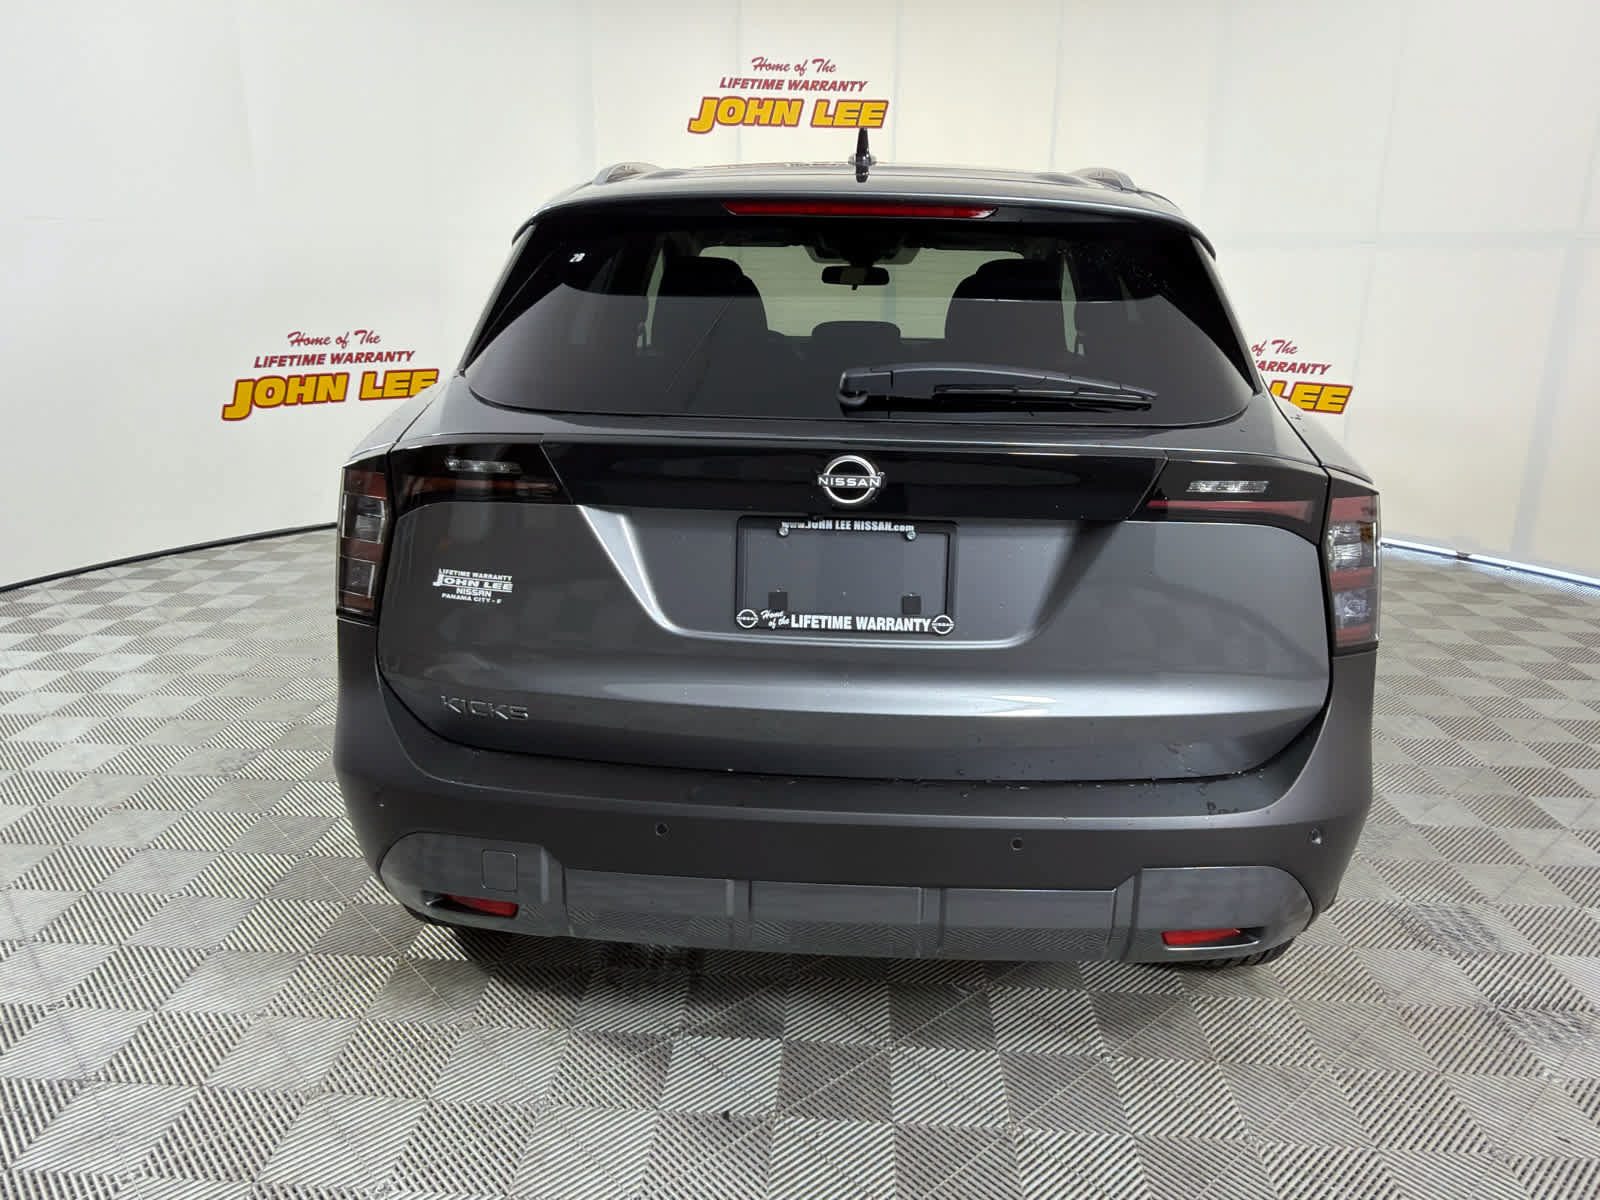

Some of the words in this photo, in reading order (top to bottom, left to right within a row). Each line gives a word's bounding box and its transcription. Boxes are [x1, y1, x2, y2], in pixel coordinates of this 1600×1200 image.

[751, 56, 790, 72] Home
[794, 59, 808, 76] of
[812, 58, 836, 73] The
[719, 77, 784, 90] LIFETIME
[787, 79, 868, 92] WARRANTY
[687, 95, 804, 134] JOHN
[810, 99, 889, 128] LEE
[287, 331, 331, 347] Home
[335, 332, 350, 349] of
[353, 329, 381, 345] The
[1250, 340, 1267, 357] of
[1271, 339, 1298, 354] The
[253, 353, 326, 369] LIFETIME
[330, 350, 416, 365] WARRANTY
[1255, 360, 1332, 375] ARRANTY
[221, 372, 350, 422] JOHN
[358, 368, 440, 401] LEE
[818, 476, 880, 487] NISSAN
[835, 519, 852, 530] LEE
[432, 575, 480, 587] JOHN
[483, 581, 514, 591] LEE
[439, 568, 471, 577] LIFETIME
[472, 572, 512, 581] WARRANTY
[441, 593, 472, 601] PANAMA
[456, 588, 492, 597] NISSAN
[791, 614, 853, 630] LIFETIME
[855, 615, 932, 632] WARRANTY
[440, 695, 529, 720] KICKS
